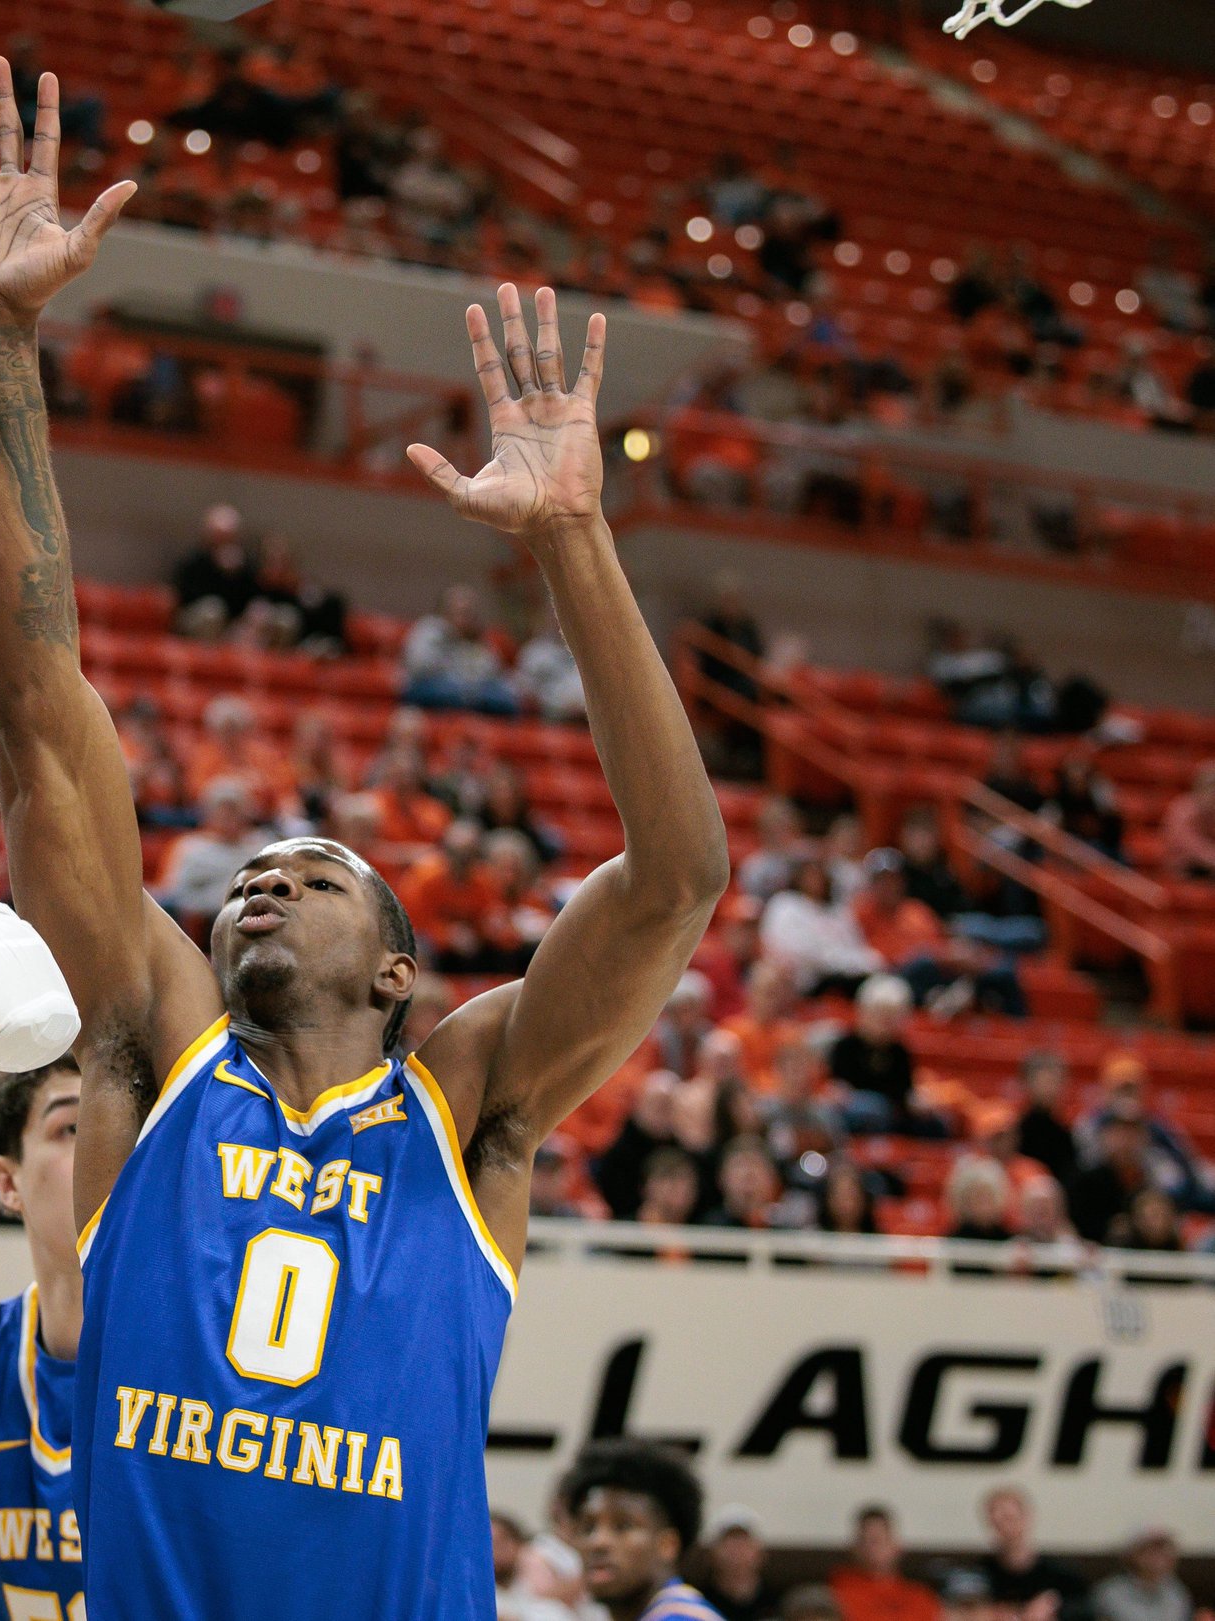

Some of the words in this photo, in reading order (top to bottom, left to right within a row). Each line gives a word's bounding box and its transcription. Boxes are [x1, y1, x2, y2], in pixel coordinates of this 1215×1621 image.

[217, 1143, 382, 1224] WEST
[225, 1227, 340, 1388] 0
[114, 1386, 403, 1501] VIRGINIA
